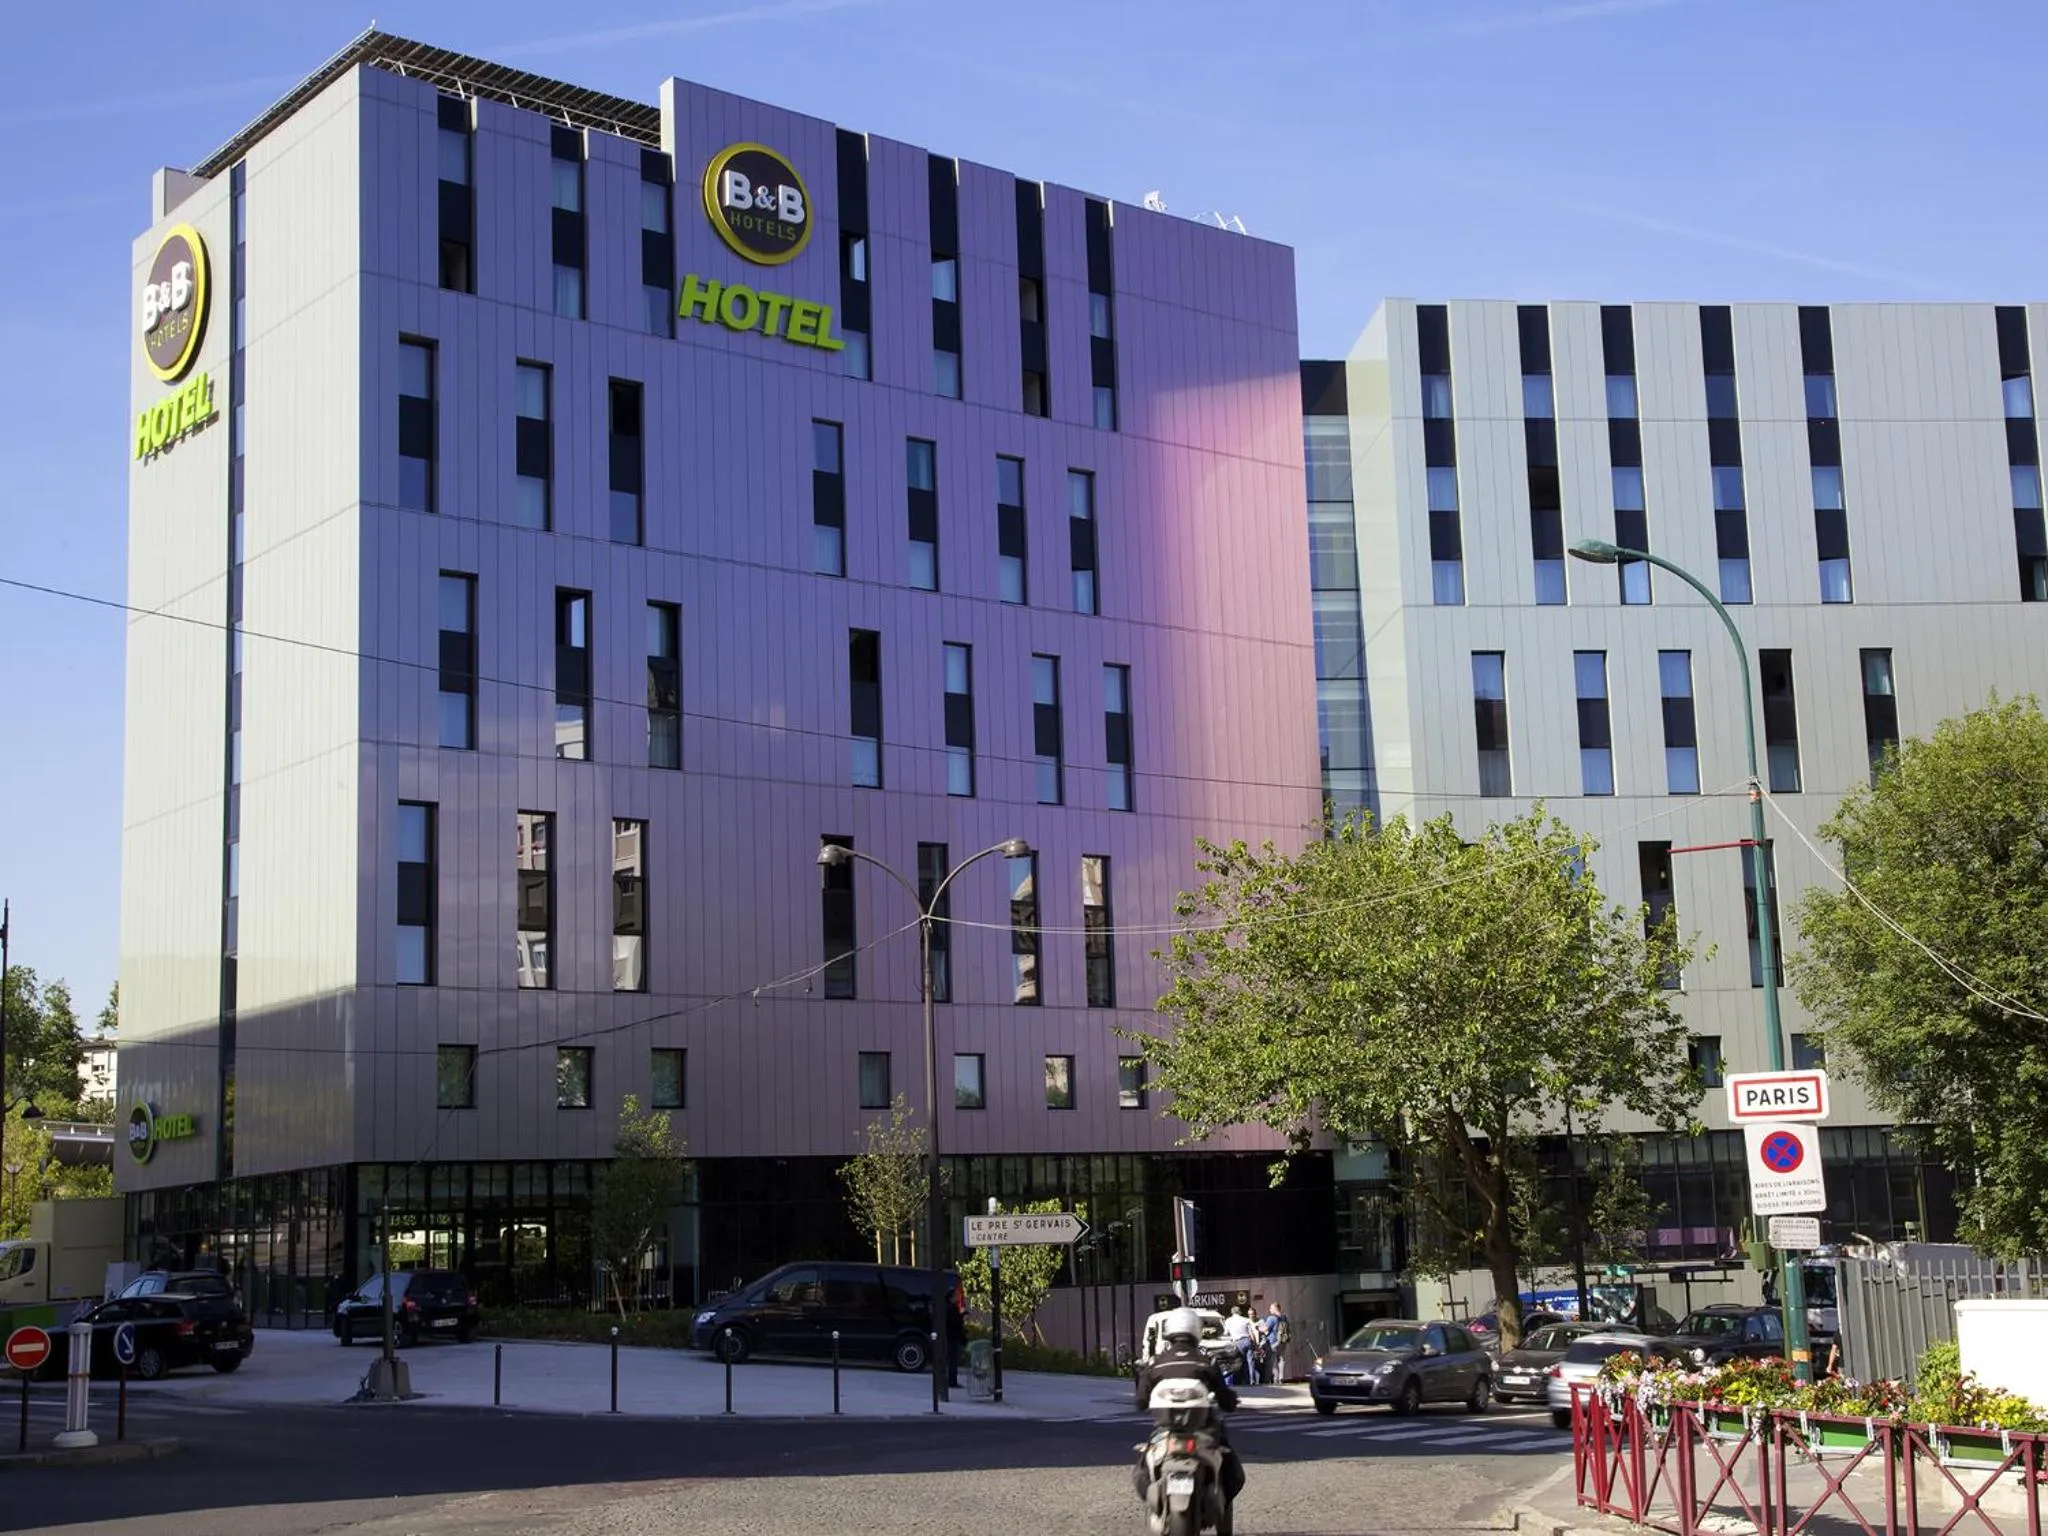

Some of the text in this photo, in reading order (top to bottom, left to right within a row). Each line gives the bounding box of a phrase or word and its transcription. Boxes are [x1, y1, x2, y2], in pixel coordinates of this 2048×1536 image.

[724, 169, 806, 225] B&B
[730, 211, 797, 242] HOTELS
[142, 260, 192, 333] B&B
[679, 273, 846, 351] HOTEL
[150, 311, 189, 349] HOTELS
[135, 372, 213, 461] HOTEL
[1746, 1086, 1810, 1107] PARIS
[154, 1113, 195, 1141] HOTEL
[971, 1221, 982, 1231] LE
[1026, 1219, 1071, 1230] GERVAIS
[1188, 1293, 1225, 1307] ARKING
